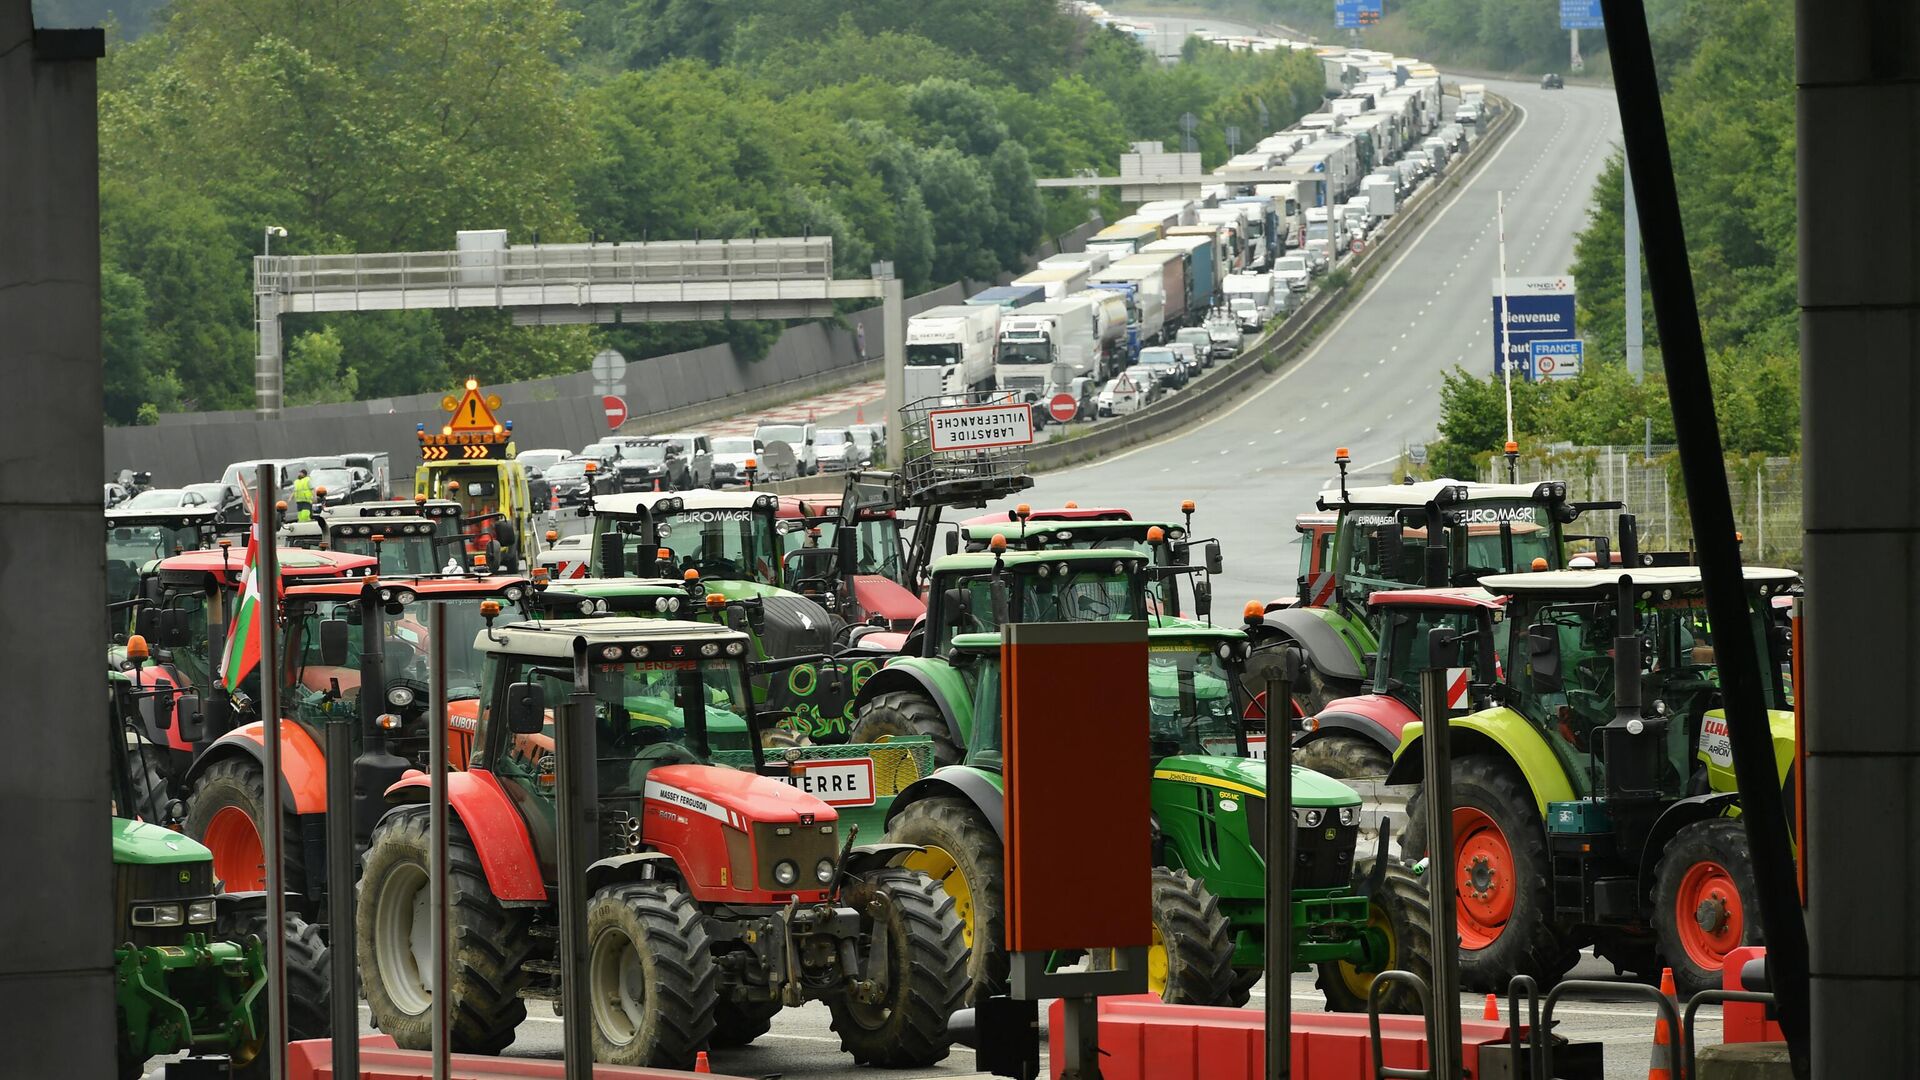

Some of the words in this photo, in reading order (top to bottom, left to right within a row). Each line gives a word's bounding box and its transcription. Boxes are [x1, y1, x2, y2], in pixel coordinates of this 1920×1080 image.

[1536, 344, 1578, 354] FRANCE
[936, 412, 1025, 429] VILLEFRANCHE
[950, 427, 1015, 442] LABASTIDE
[676, 510, 753, 523] EUROMAGRI
[1460, 507, 1535, 523] EUROMAGRI
[450, 714, 478, 731] KUBOT
[1704, 720, 1729, 737] CLAA
[660, 789, 680, 802] MASSEY
[680, 796, 708, 812] FERGUSON
